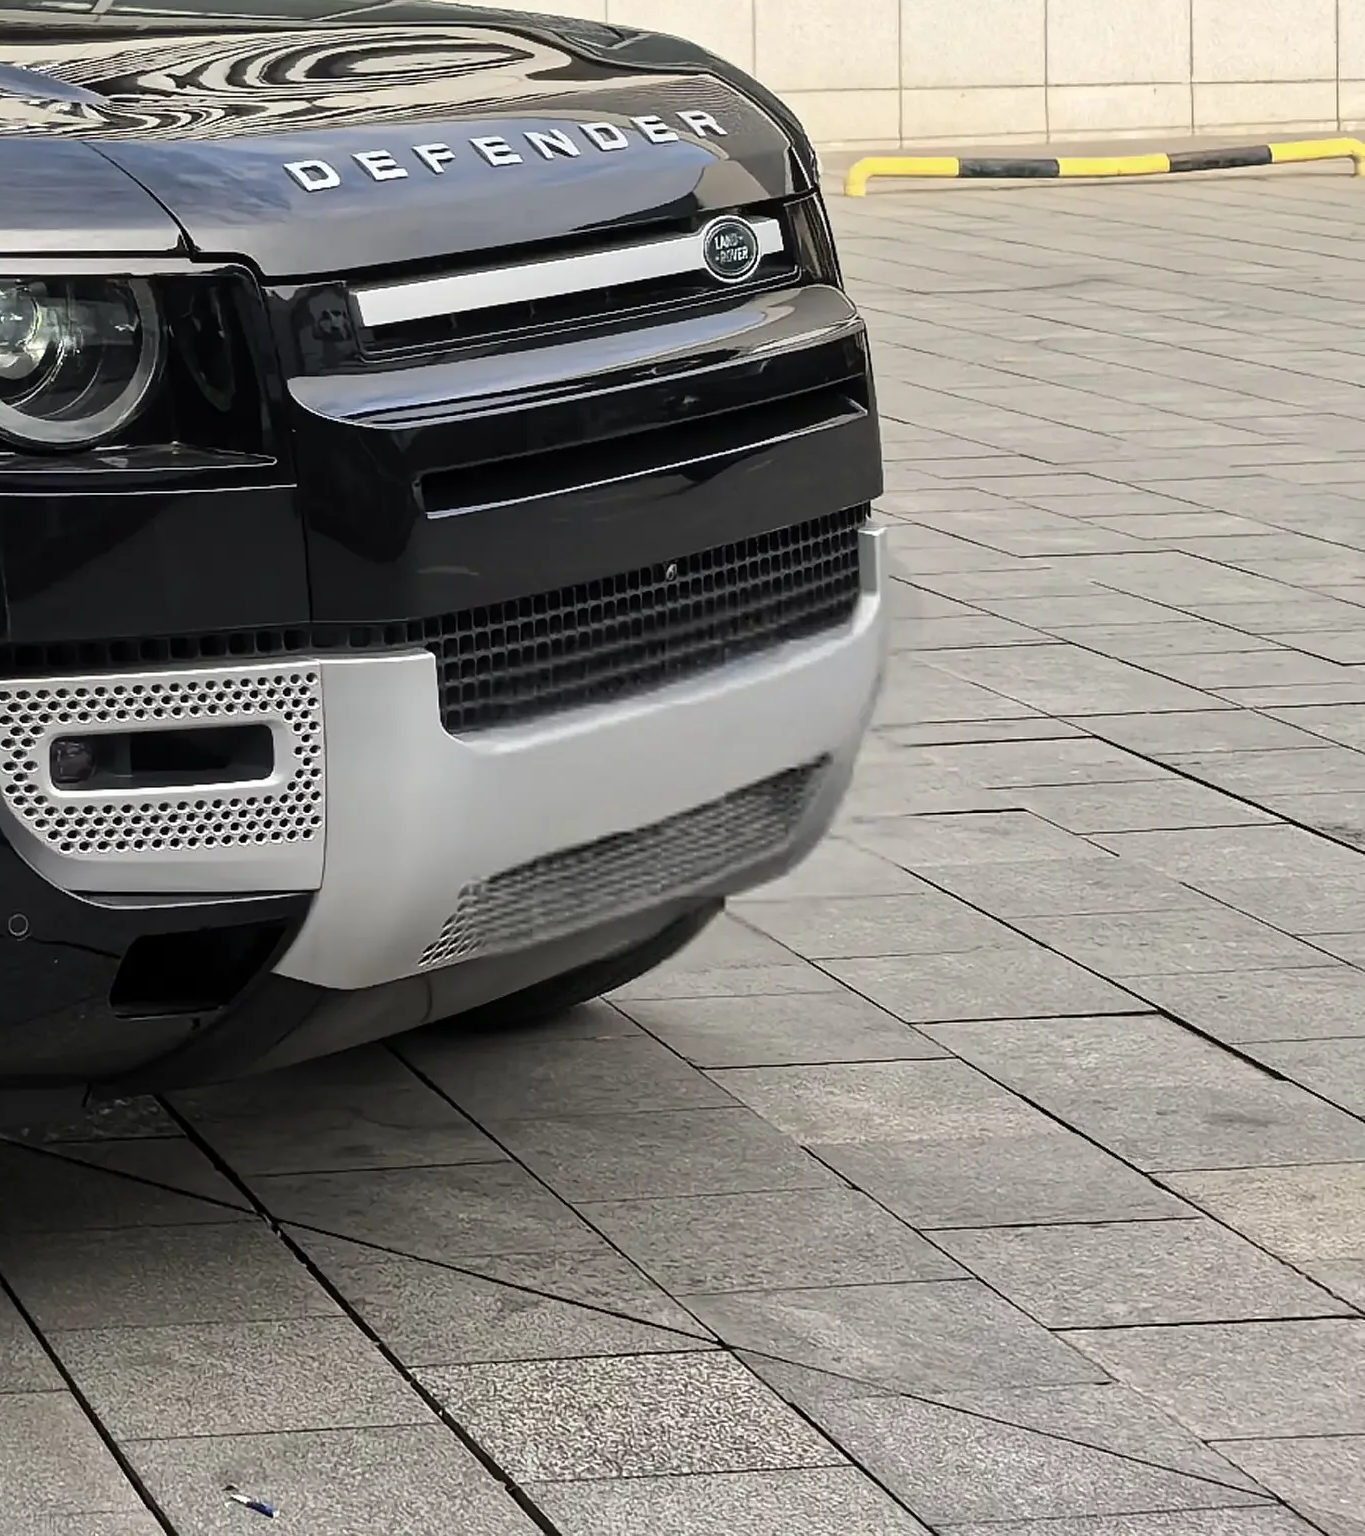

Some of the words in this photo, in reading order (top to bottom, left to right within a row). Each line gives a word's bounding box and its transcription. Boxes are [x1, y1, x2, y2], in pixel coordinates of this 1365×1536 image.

[283, 110, 728, 192] DEFENDER
[714, 233, 738, 250] LAND
[719, 245, 748, 264] ROVER
